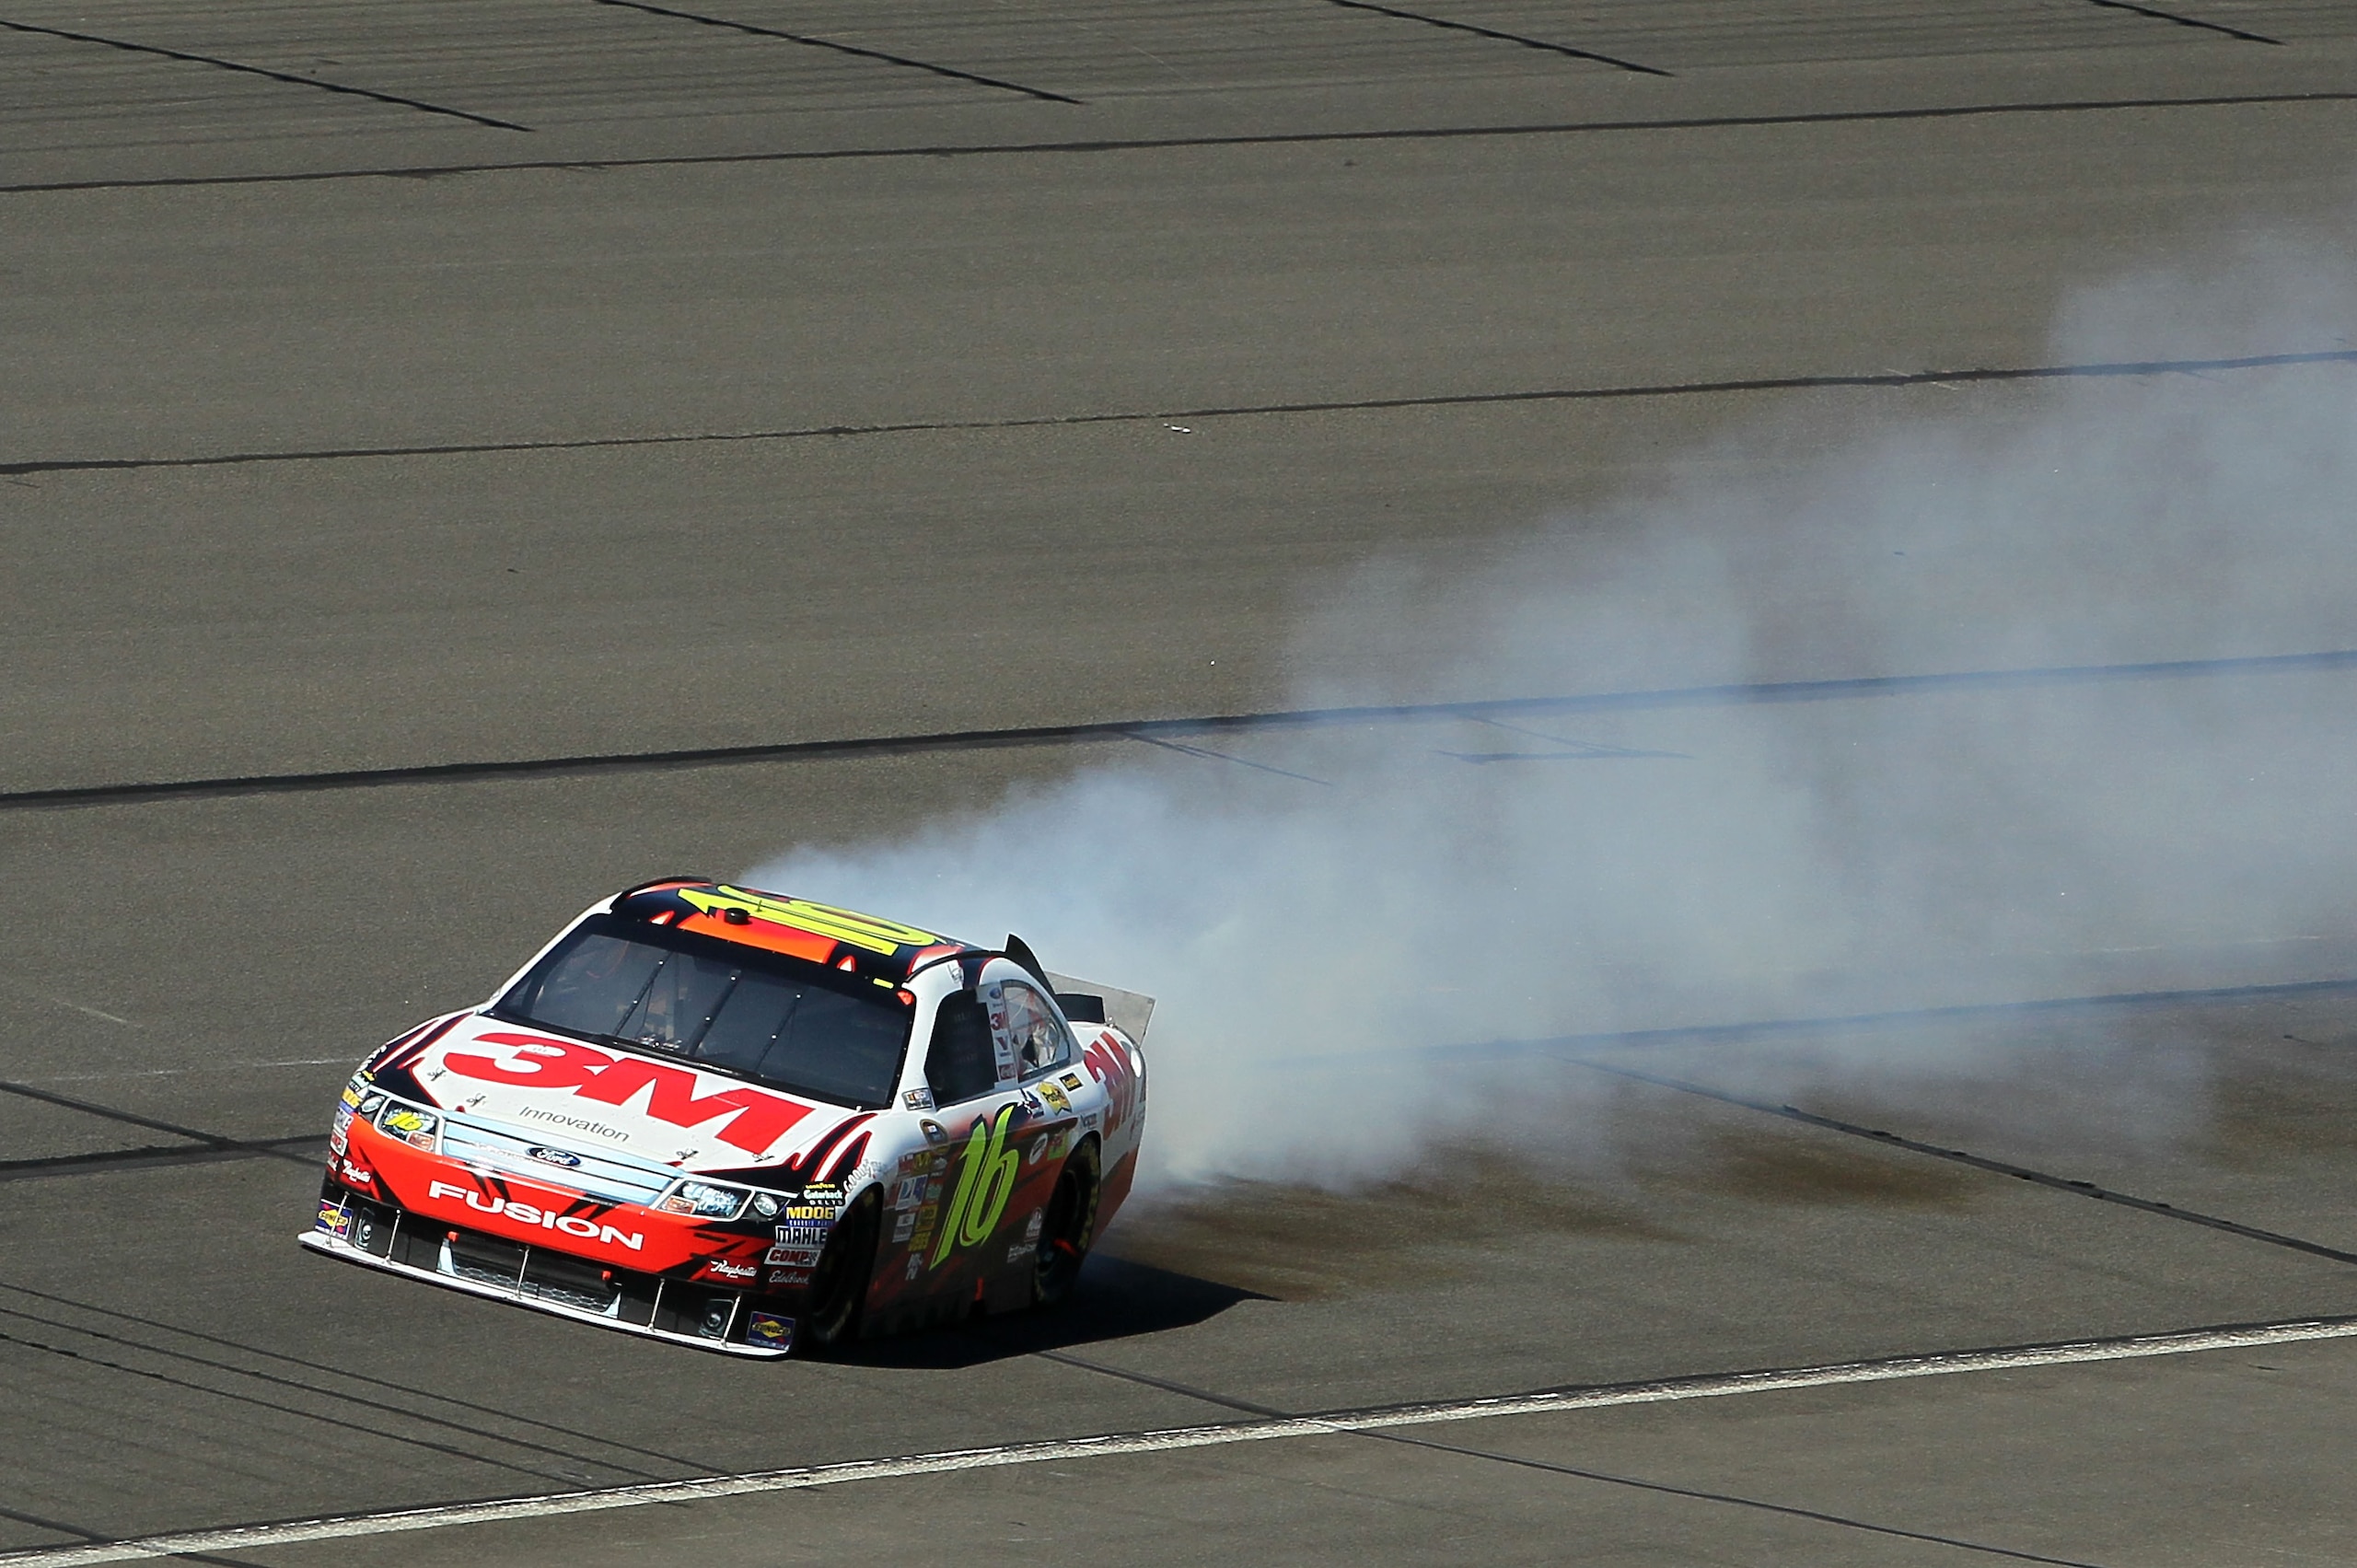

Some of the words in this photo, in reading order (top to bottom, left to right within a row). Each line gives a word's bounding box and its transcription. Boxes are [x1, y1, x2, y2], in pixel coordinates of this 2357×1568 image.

[444, 1032, 818, 1156] 3M
[385, 1112, 424, 1131] 16
[518, 1106, 631, 1143] Innovation
[537, 1148, 574, 1166] Ford
[929, 1104, 1020, 1271] 16
[428, 1180, 644, 1251] FUSION
[786, 1206, 835, 1220] MOOG
[777, 1227, 828, 1244] MAHLE
[770, 1249, 810, 1263] COMP
